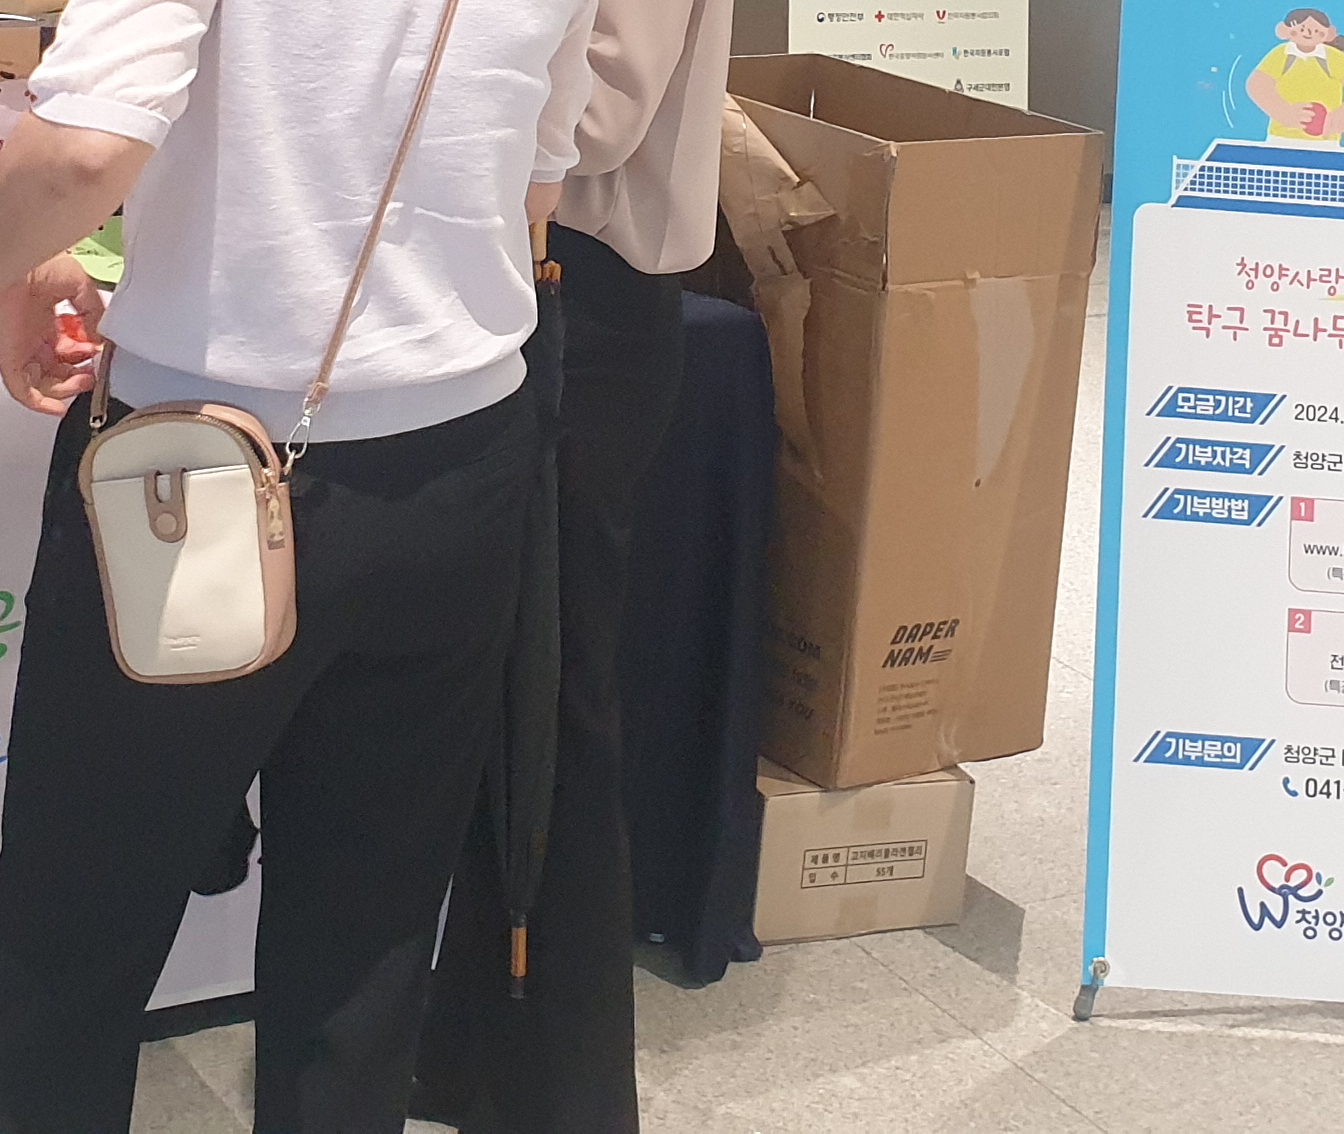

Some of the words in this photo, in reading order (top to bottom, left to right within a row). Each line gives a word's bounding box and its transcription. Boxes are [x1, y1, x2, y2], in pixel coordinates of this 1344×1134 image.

[1186, 304, 1249, 341] 탁구
[1176, 392, 1253, 417] 모금기간
[1294, 403, 1344, 424] 2024.
[1175, 443, 1250, 468] 기부자격
[1173, 494, 1249, 520] 기부방법
[1298, 501, 1306, 517] 1
[890, 618, 960, 645] DAPER
[1294, 613, 1305, 628] 2
[882, 645, 934, 668] NAM
[1164, 737, 1242, 763] 기부문의
[1283, 744, 1336, 767] 청양군
